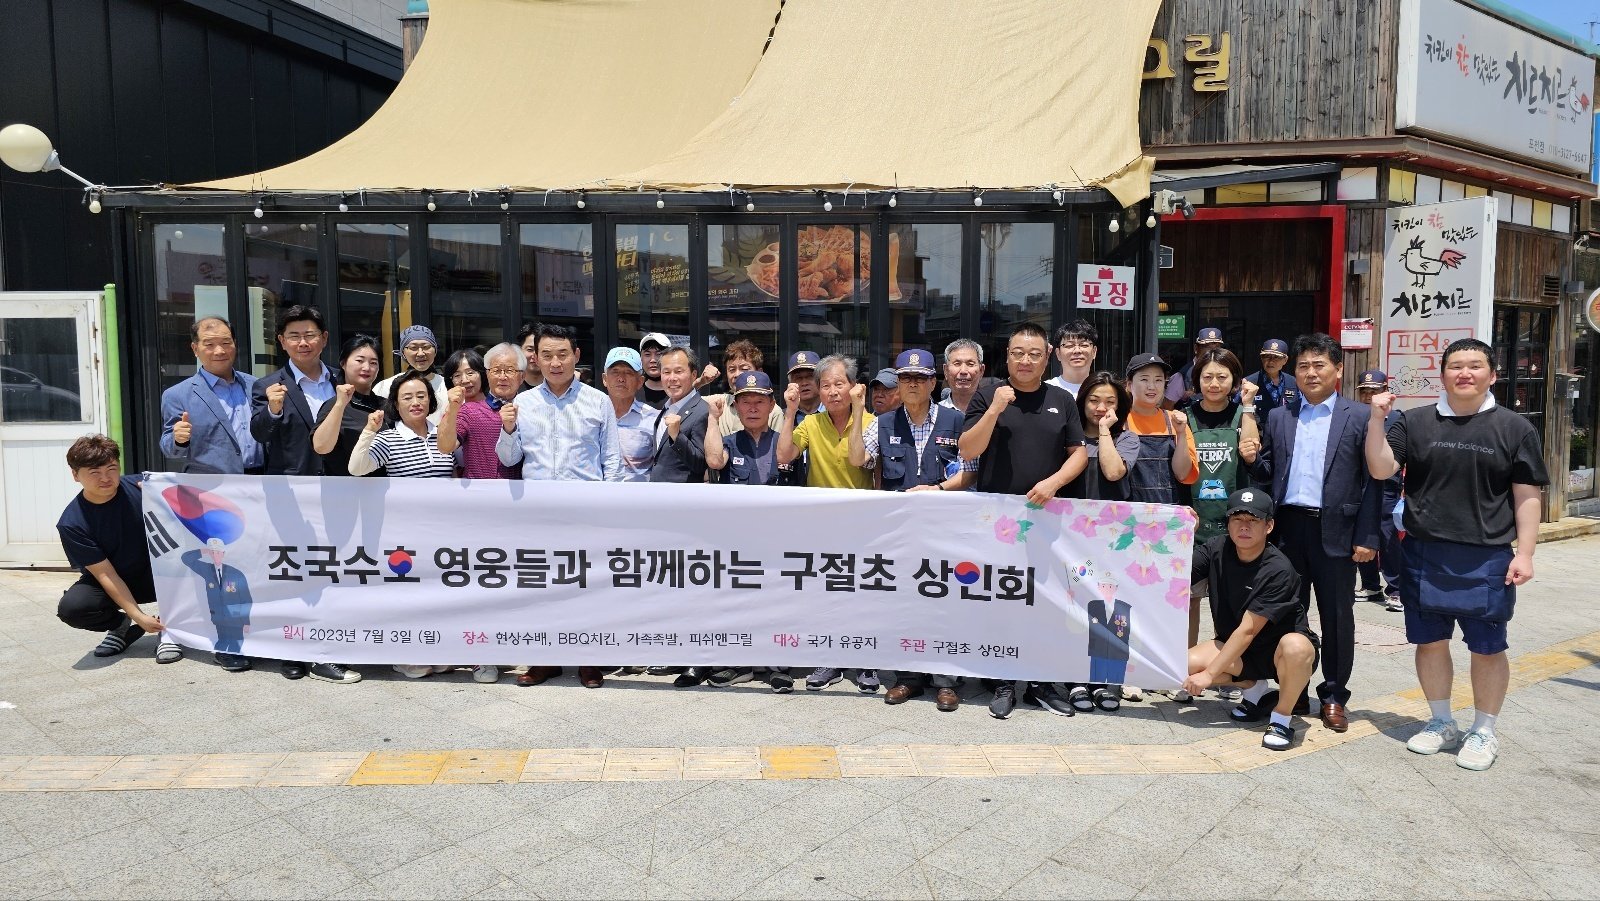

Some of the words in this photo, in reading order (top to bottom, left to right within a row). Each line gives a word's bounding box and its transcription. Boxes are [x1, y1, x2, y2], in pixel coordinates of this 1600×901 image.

[1424, 34, 1453, 63] 치킨이
[1456, 34, 1470, 77] 참
[1473, 53, 1500, 86] 맛있는
[1503, 50, 1570, 115] 치르치르
[1392, 217, 1423, 233] 치킨이
[1427, 208, 1445, 230] 참
[1441, 226, 1479, 244] 맛있는
[1082, 281, 1128, 307] 포장
[1390, 287, 1473, 319] 치르치르
[1437, 441, 1456, 449] new
[1458, 442, 1495, 455] balance
[267, 545, 421, 585] 조국수호
[433, 547, 592, 589] 영웅들과
[606, 547, 765, 590] 함께하는
[779, 551, 897, 592] 구절초
[911, 558, 1036, 606] 상인회
[282, 625, 304, 641] 일시
[309, 628, 356, 643] 2023년
[362, 629, 384, 644] 7월
[390, 630, 411, 644] 3일
[418, 630, 441, 645] (월)
[462, 631, 489, 645] 장소
[495, 632, 552, 647] 현상수배,
[558, 632, 620, 647] BBQ치킨,
[626, 632, 683, 647] 가족족발,
[689, 632, 752, 647] 피쉬앤그릴
[774, 633, 800, 648] 대상
[807, 634, 833, 648] 국가
[839, 635, 878, 649] 유공자
[900, 638, 926, 653] 주관
[932, 640, 971, 655] 구절초
[977, 643, 1020, 659] 상인회
